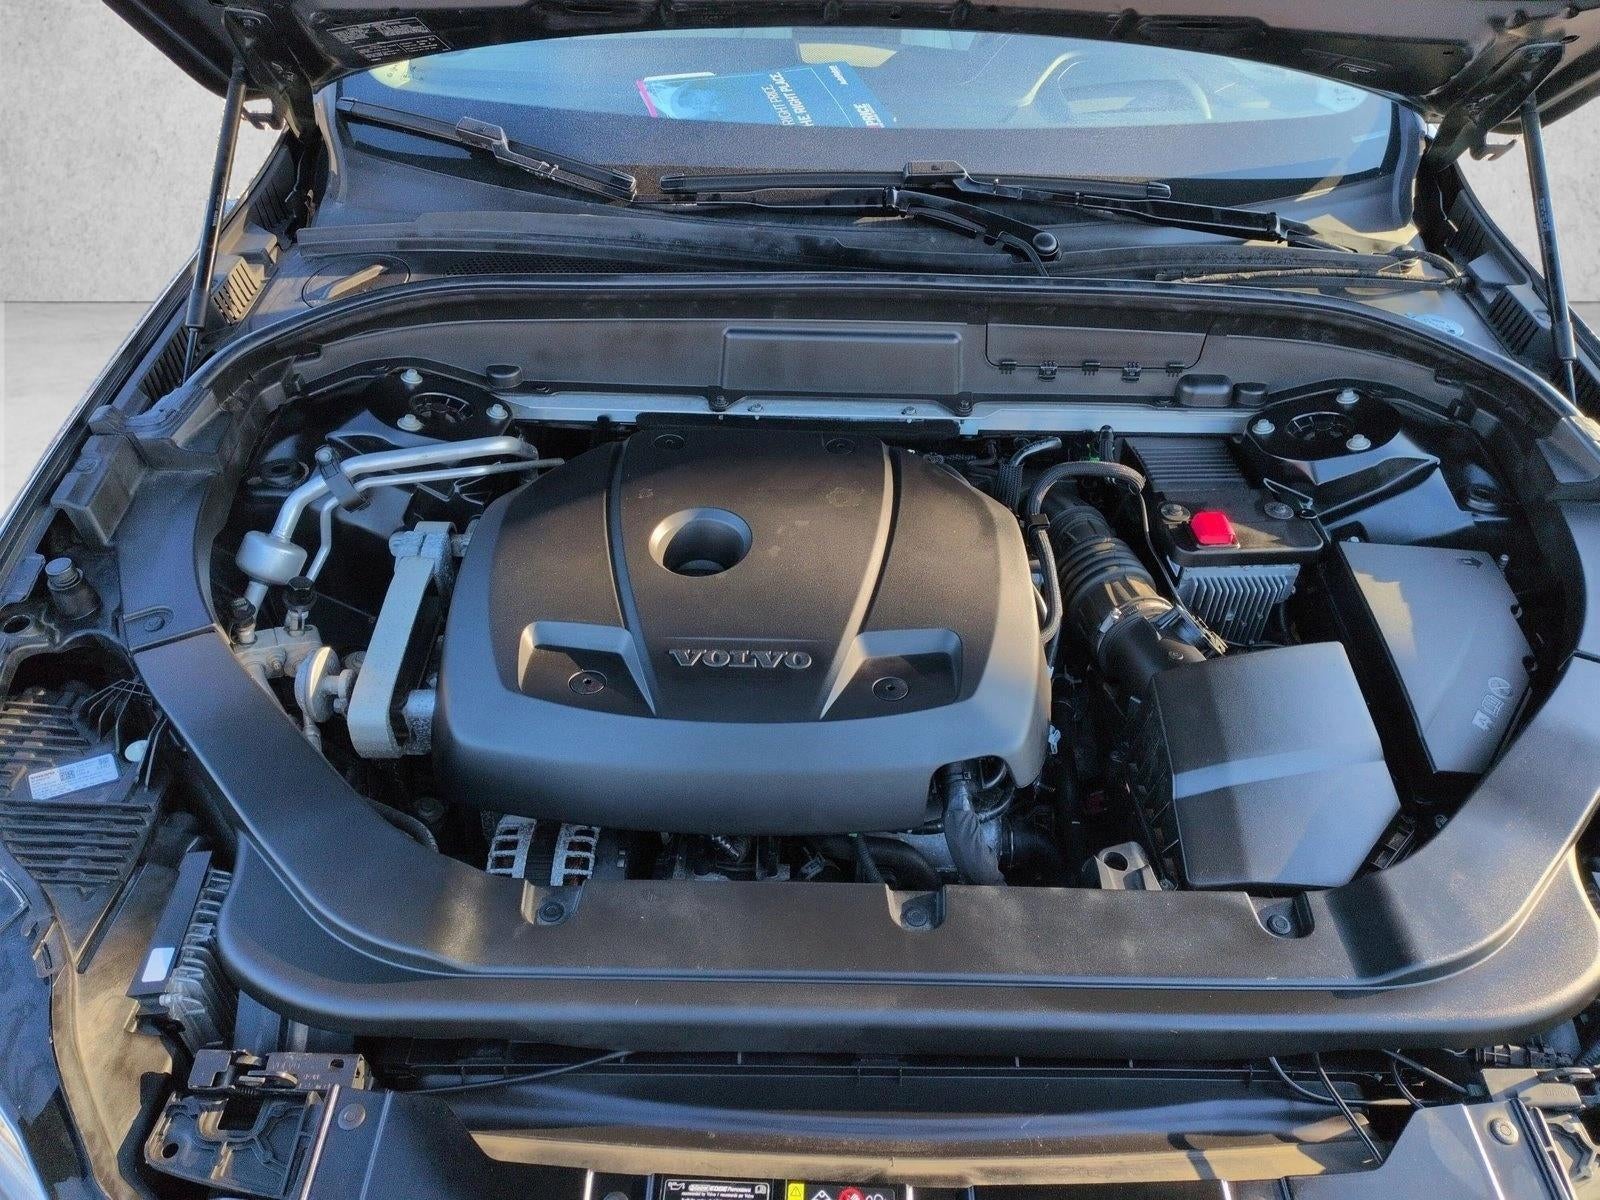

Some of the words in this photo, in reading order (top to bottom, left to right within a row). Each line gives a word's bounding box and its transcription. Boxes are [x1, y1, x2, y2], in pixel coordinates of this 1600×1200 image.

[769, 72, 792, 93] PLACE
[761, 84, 783, 104] PRICE
[783, 92, 807, 114] RIGHT
[772, 103, 796, 126] RIGHT
[797, 113, 814, 127] HE
[668, 649, 812, 669] VOLVO
